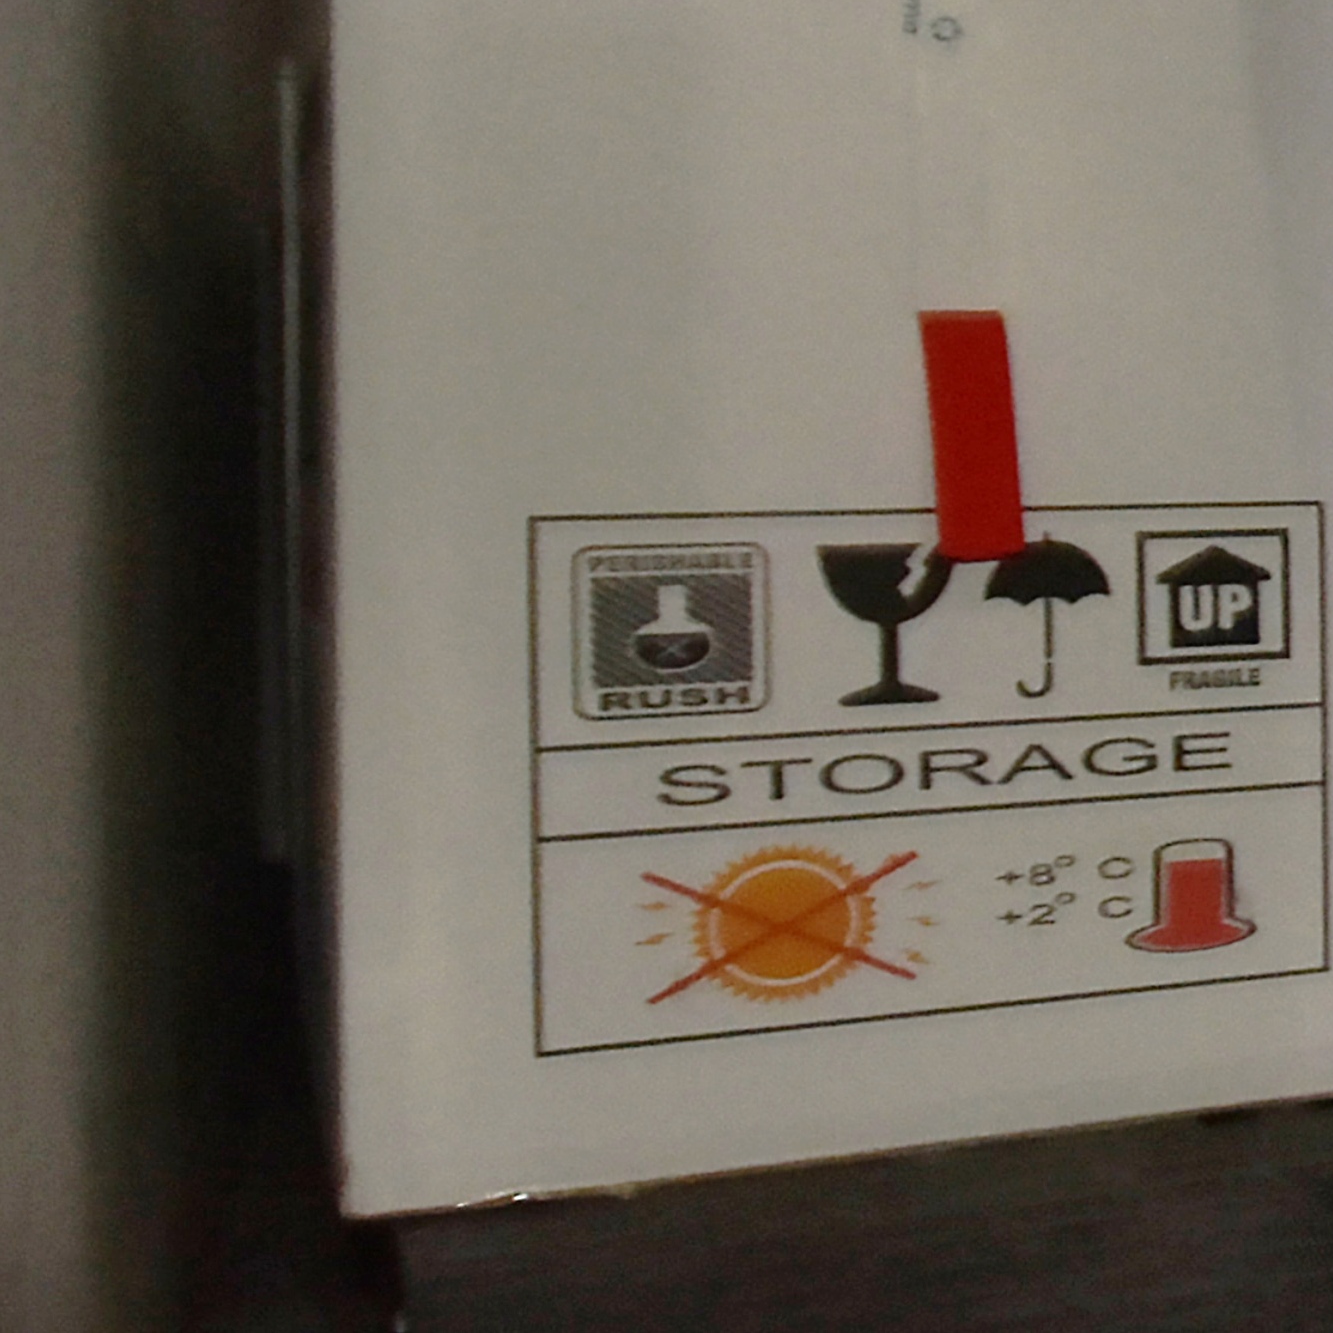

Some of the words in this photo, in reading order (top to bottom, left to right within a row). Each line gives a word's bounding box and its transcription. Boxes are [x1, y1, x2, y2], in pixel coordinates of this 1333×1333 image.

[1178, 584, 1253, 632] UP
[1170, 668, 1262, 691] FRAGILE
[600, 686, 749, 711] RUSH
[656, 732, 1233, 807] STORAGE
